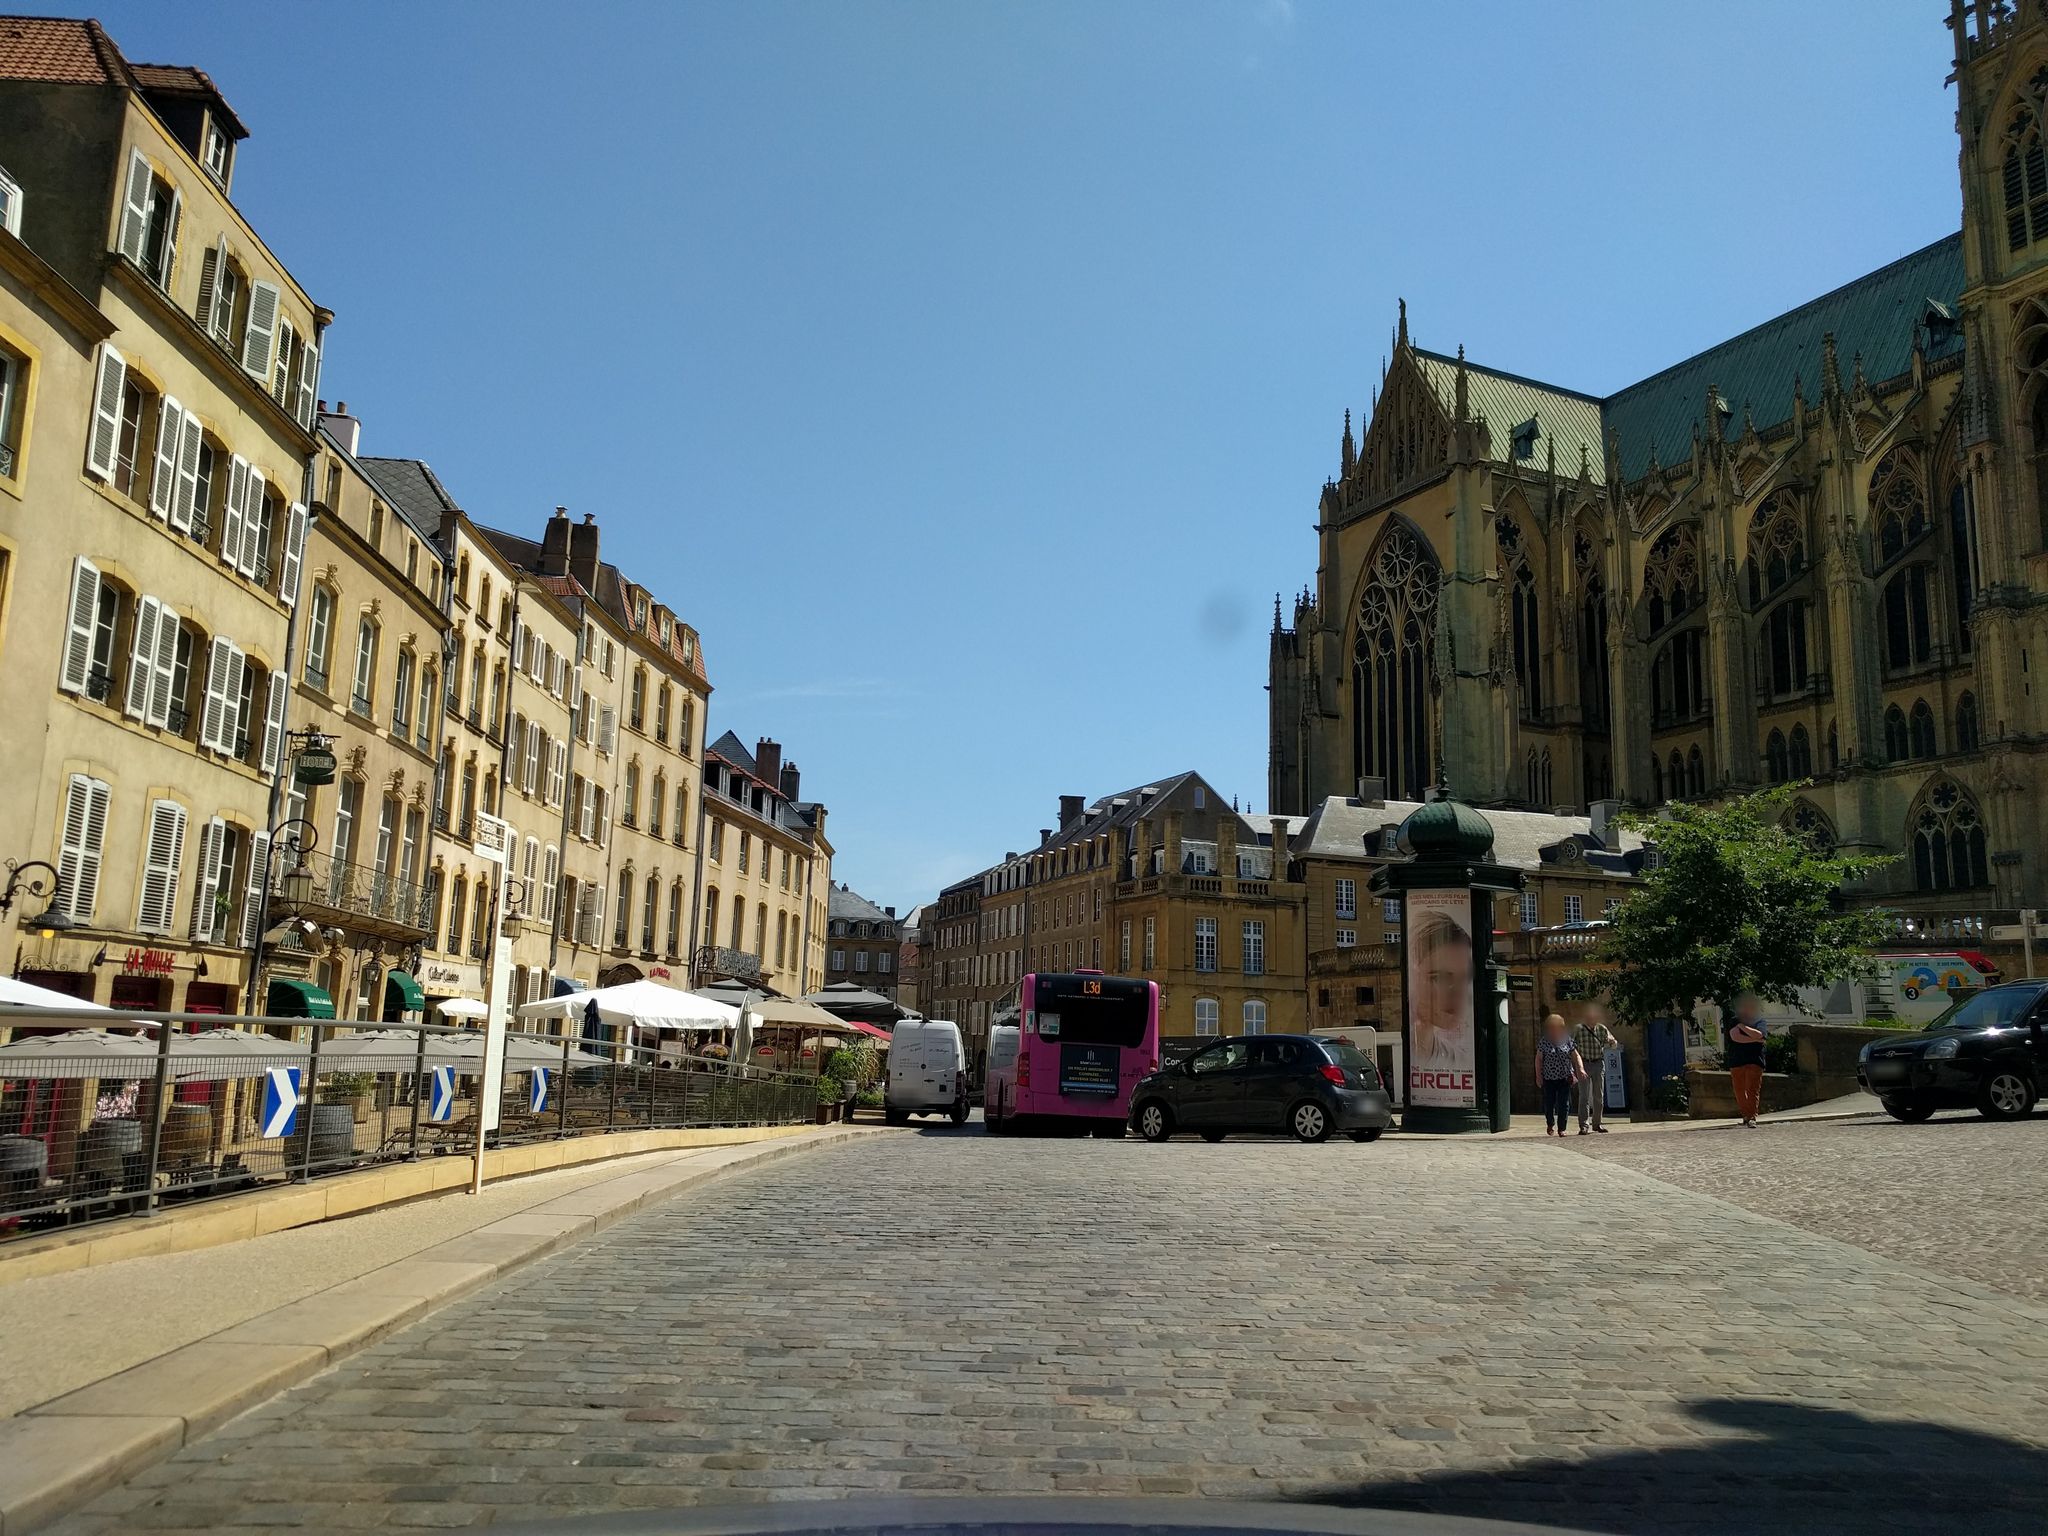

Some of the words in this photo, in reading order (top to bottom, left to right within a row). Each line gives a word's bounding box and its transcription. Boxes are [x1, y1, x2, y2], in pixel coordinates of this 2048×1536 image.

[300, 756, 335, 769] HOTEL
[127, 947, 140, 971] LA
[143, 949, 175, 973] QUILLE
[1083, 981, 1100, 994] L3d
[1909, 988, 1915, 999] 3
[1411, 1072, 1474, 1090] CIRCLE
